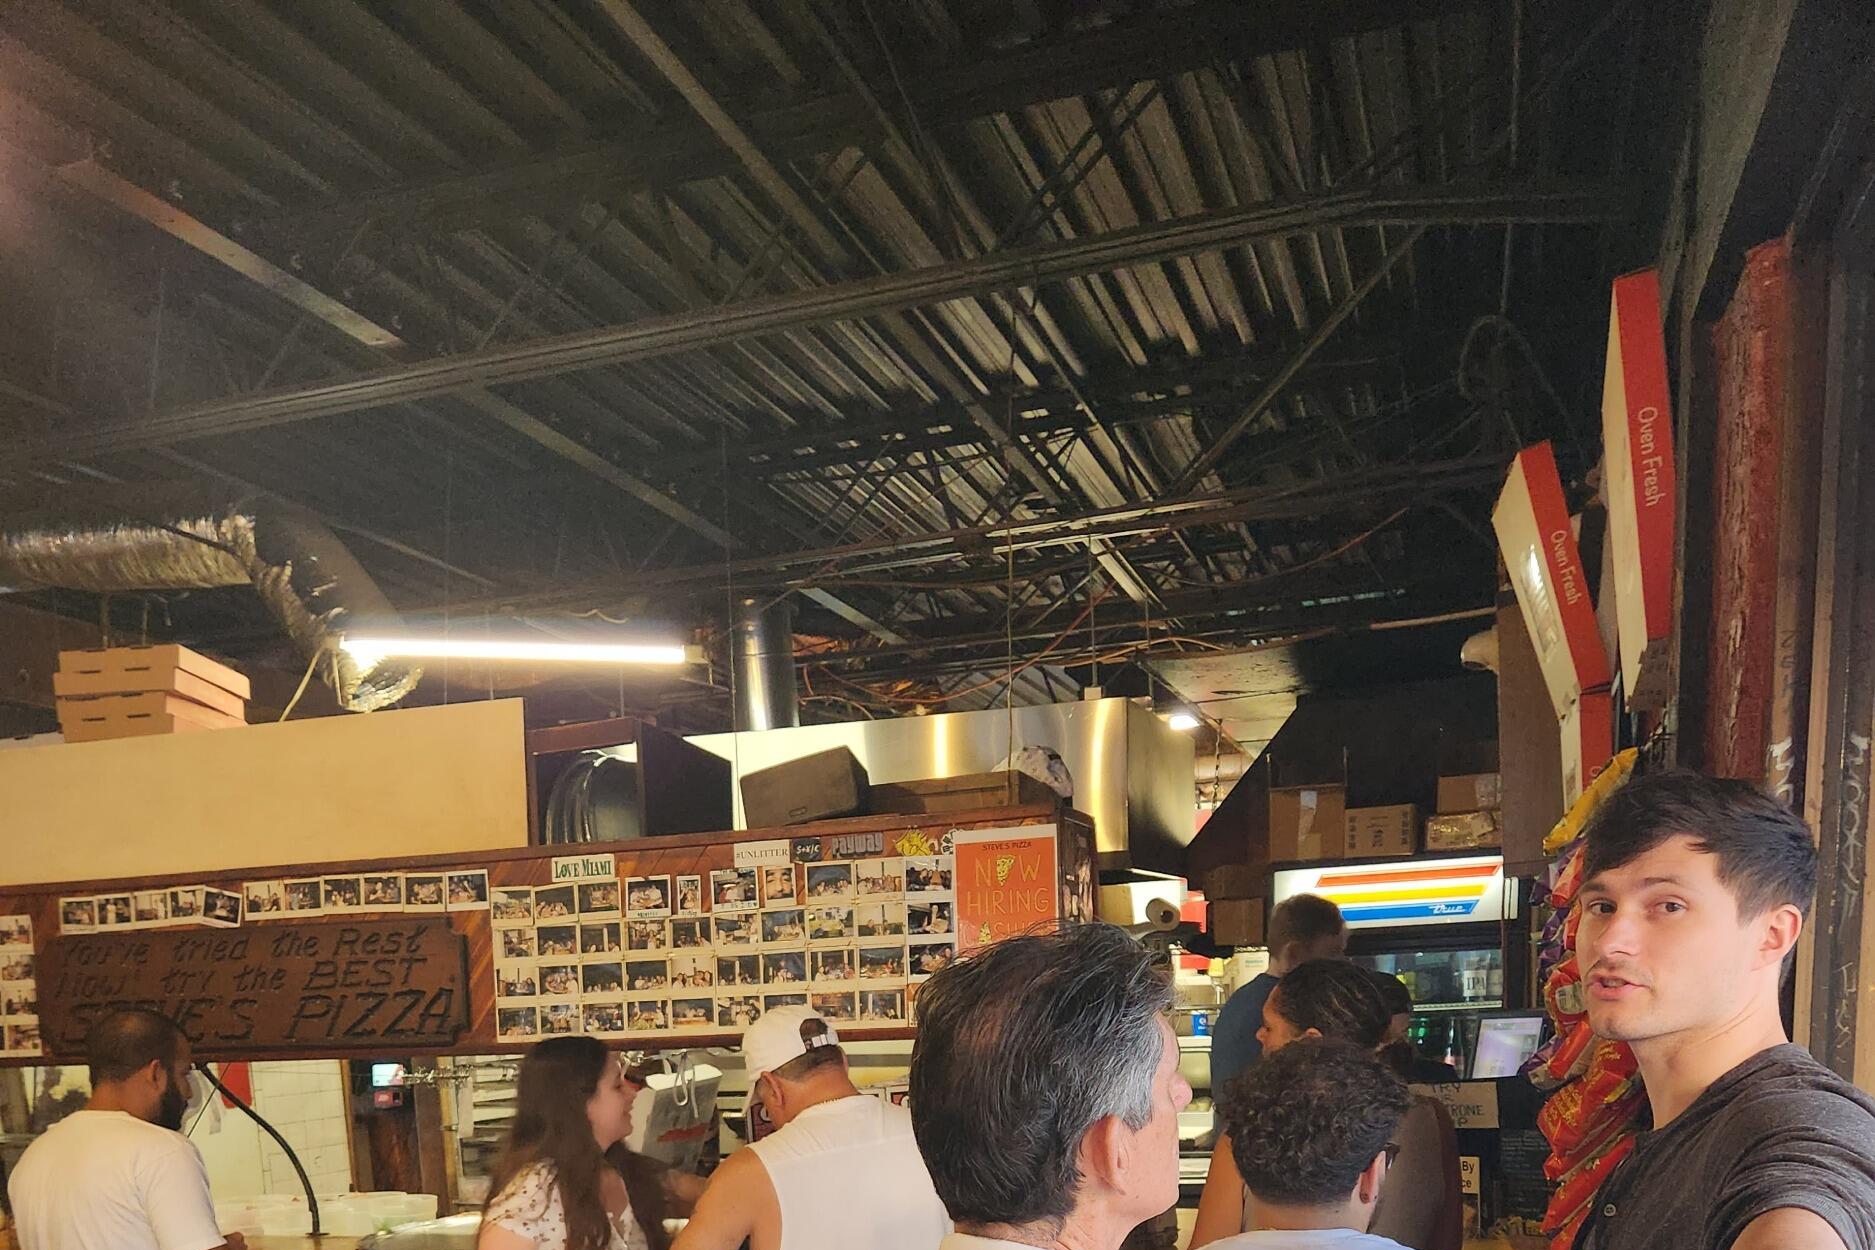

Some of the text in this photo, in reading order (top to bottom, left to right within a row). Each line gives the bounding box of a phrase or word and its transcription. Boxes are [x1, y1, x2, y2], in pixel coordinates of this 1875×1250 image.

[1638, 406, 1666, 507] Oven Fresh
[1551, 530, 1582, 605] Oven Fresh
[736, 847, 789, 860] #UNLITTER
[1012, 841, 1032, 849] PIZZA
[581, 858, 611, 877] MIAMI
[967, 888, 1049, 916] HIRING
[175, 935, 249, 963] tried
[272, 929, 319, 957] the
[234, 964, 286, 991] the
[302, 957, 428, 990] BEST
[284, 987, 454, 1039] PIZZA
[1462, 1160, 1475, 1174] By
